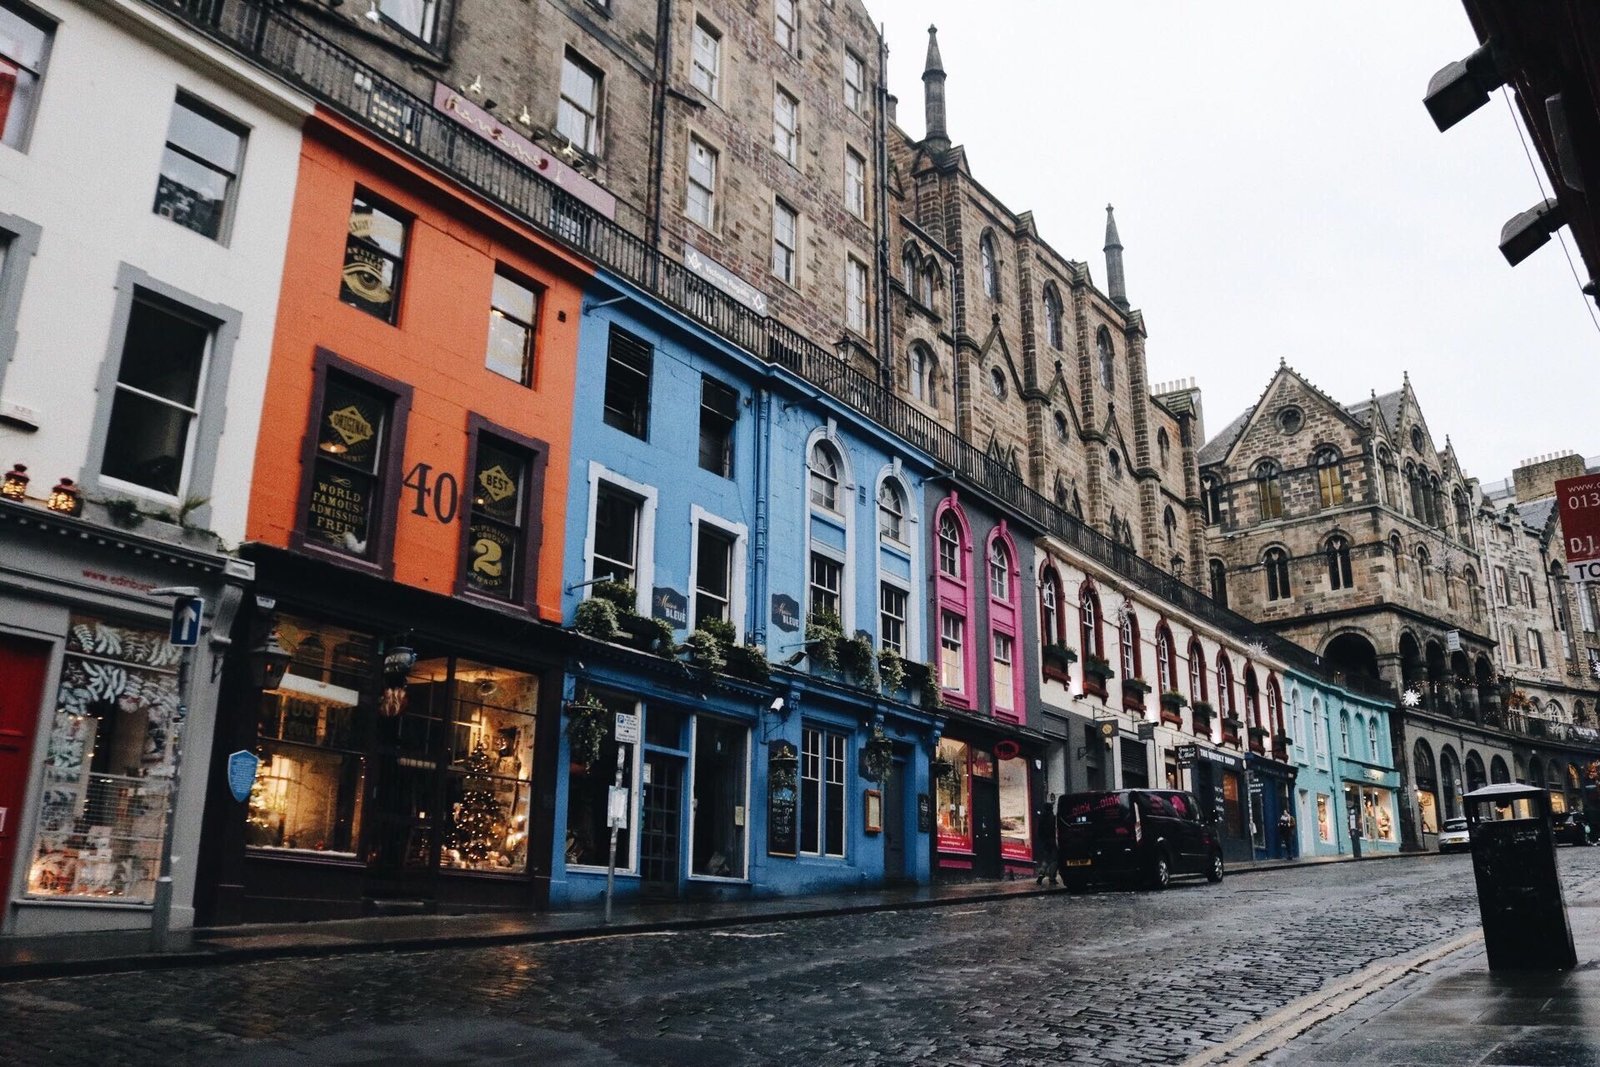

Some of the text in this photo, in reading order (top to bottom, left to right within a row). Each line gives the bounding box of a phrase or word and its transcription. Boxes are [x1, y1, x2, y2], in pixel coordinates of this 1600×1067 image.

[334, 412, 369, 438] ORIGINAL
[319, 481, 361, 502] WORLD
[403, 463, 458, 524] 40
[486, 475, 508, 492] BEST
[310, 503, 364, 526] ADMISSION
[473, 538, 503, 577] 2
